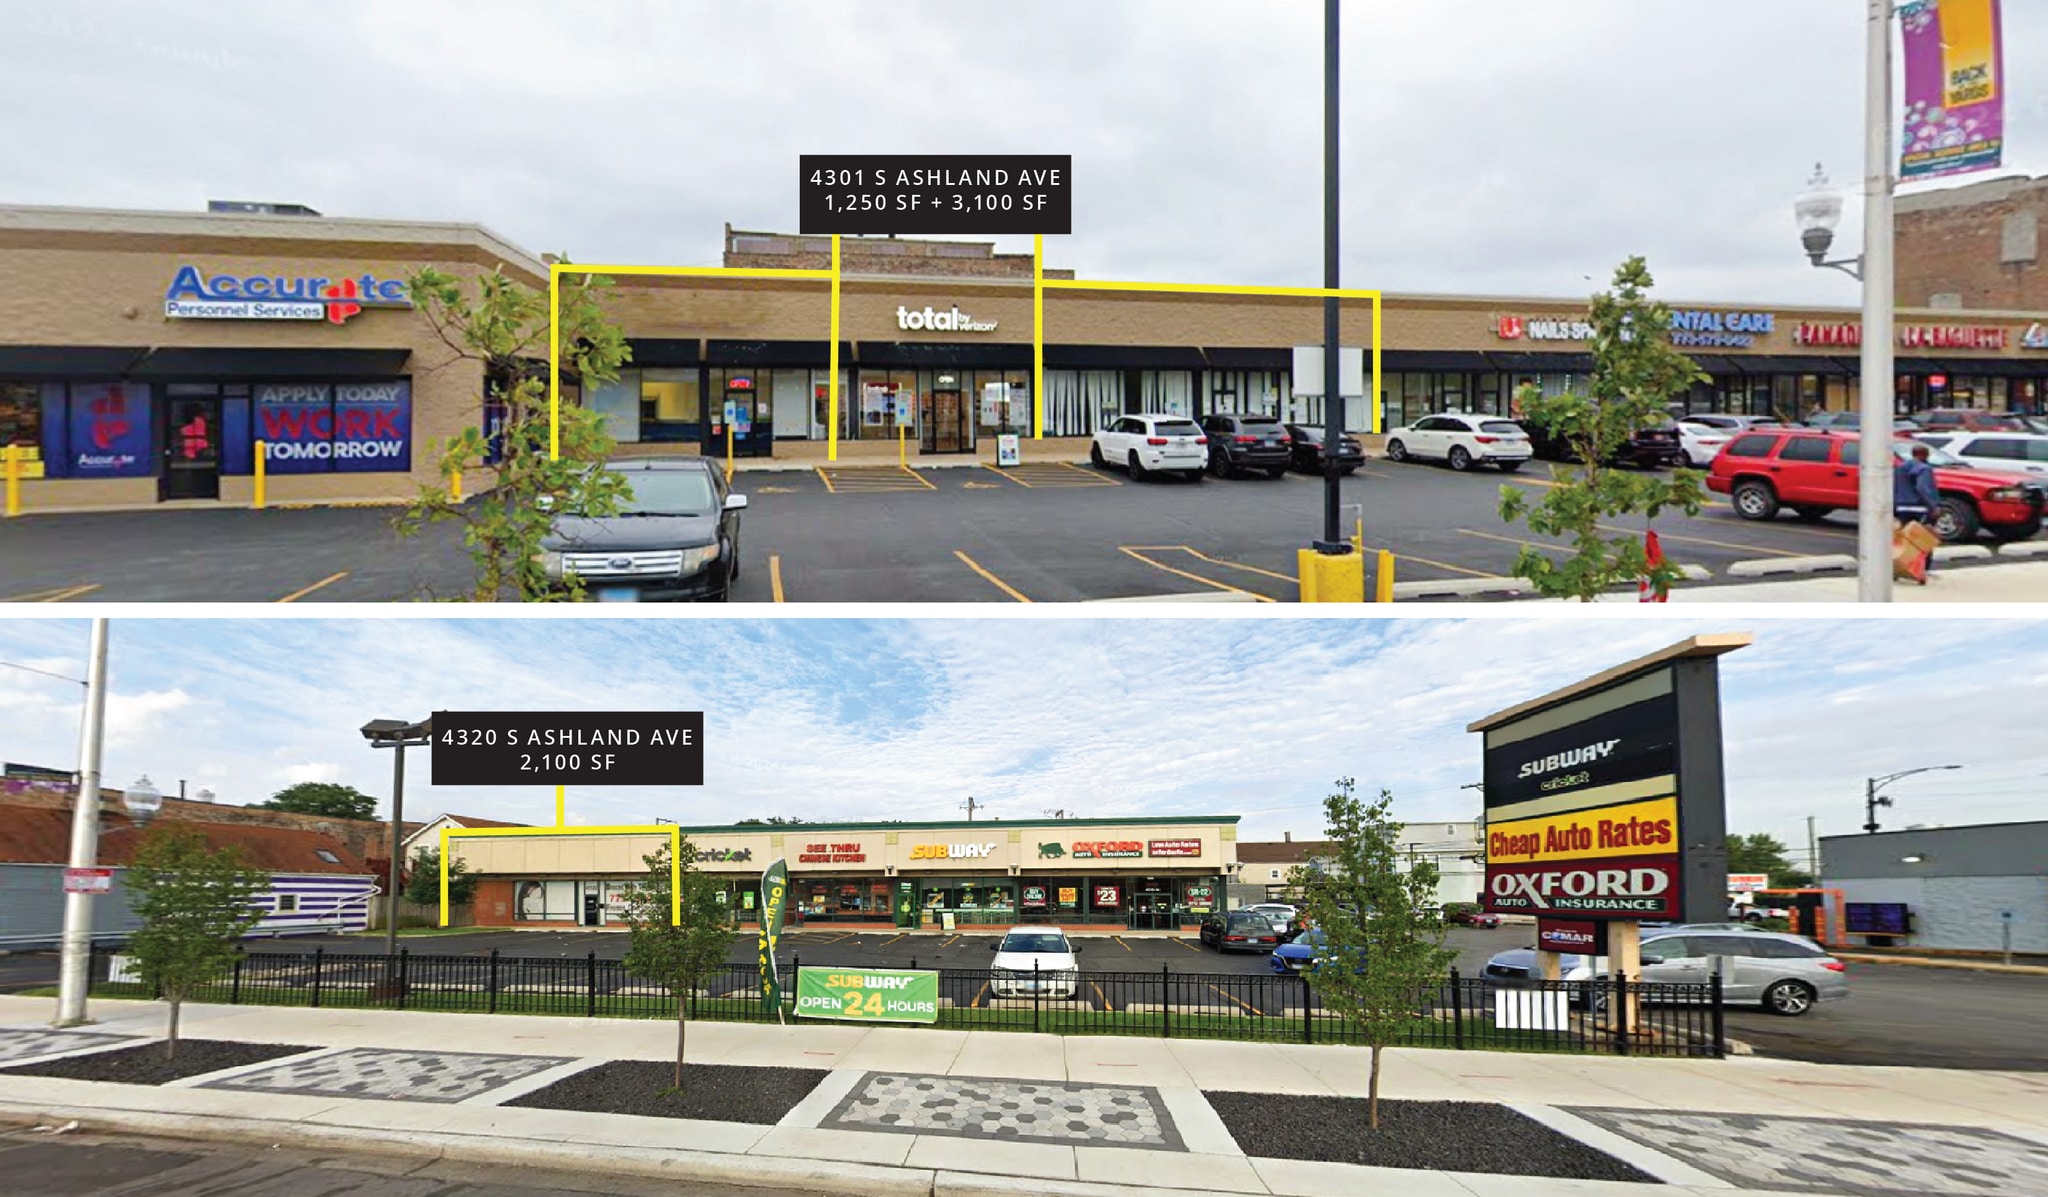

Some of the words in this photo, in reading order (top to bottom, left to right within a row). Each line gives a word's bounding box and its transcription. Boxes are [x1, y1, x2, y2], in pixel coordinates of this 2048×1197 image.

[168, 302, 248, 317] Personnel
[254, 303, 320, 318] Services
[897, 306, 958, 331] total
[1725, 312, 1775, 332] CARE
[261, 386, 328, 402] APPLY
[334, 386, 400, 402] TODAY
[261, 407, 402, 440] WORK
[264, 440, 402, 459] TOMORROW
[1518, 739, 1621, 779] SUBWAY
[1489, 831, 1540, 859] Cheap
[1544, 822, 1592, 853] Auto
[1597, 816, 1672, 849] Rates
[806, 844, 827, 853] SEE
[831, 843, 861, 853] THRU
[910, 842, 997, 861] SUBWAY
[1072, 841, 1144, 859] OXFORD
[799, 854, 831, 864] CHINESE
[833, 853, 866, 863] KITCHEN
[1491, 868, 1669, 908] OXFORD
[1494, 897, 1527, 907] AUTO
[1555, 898, 1658, 910] INSURANCE
[824, 974, 914, 990] SUBWAY
[800, 996, 842, 1009] OPEN
[843, 991, 885, 1016] 24
[887, 1001, 934, 1013] HOURS
